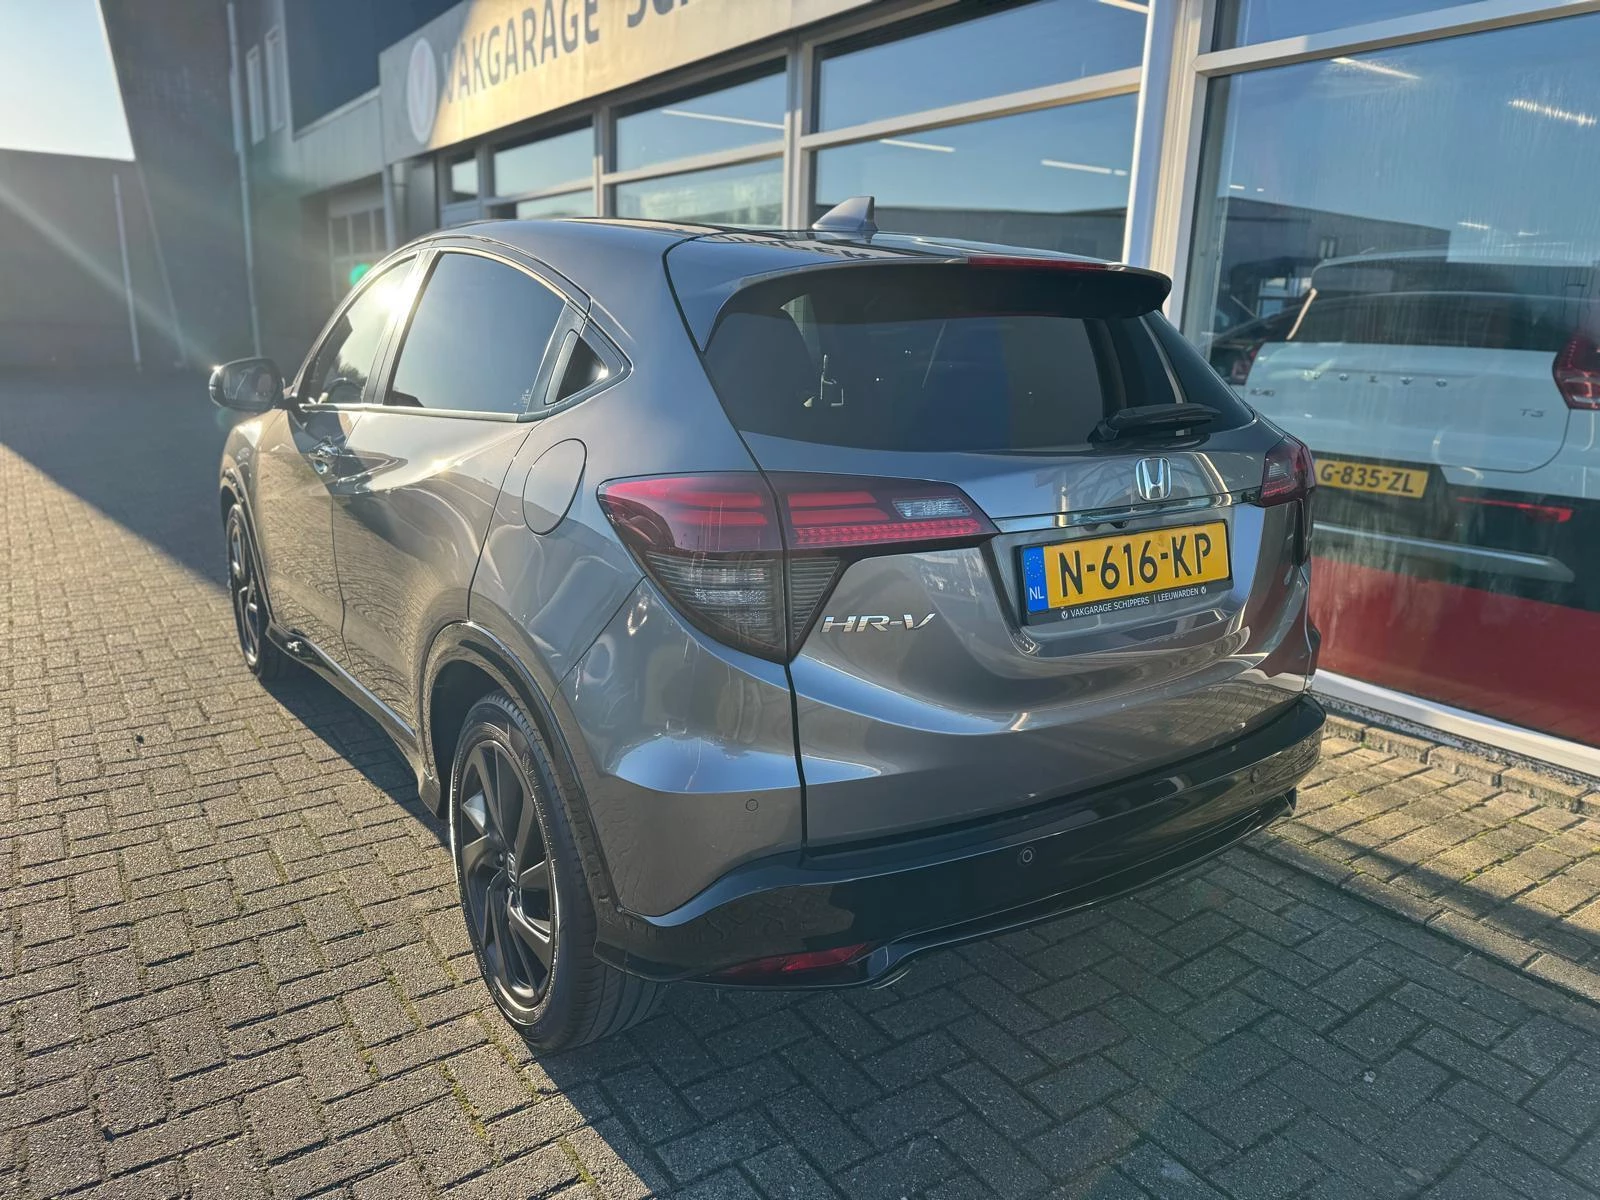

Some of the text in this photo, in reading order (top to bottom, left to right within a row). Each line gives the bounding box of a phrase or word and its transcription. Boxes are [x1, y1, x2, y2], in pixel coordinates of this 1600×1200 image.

[443, 0, 600, 104] VAKGARAGE
[1320, 463, 1414, 494] G-835-ZL
[1059, 533, 1212, 597] N-616-KP
[1029, 587, 1045, 600] NL
[1071, 603, 1112, 617] VAKGARAGE
[1113, 597, 1150, 610] SCHIPPERS
[1158, 587, 1199, 602] LEEUWARDEN
[821, 612, 936, 633] HR-V
